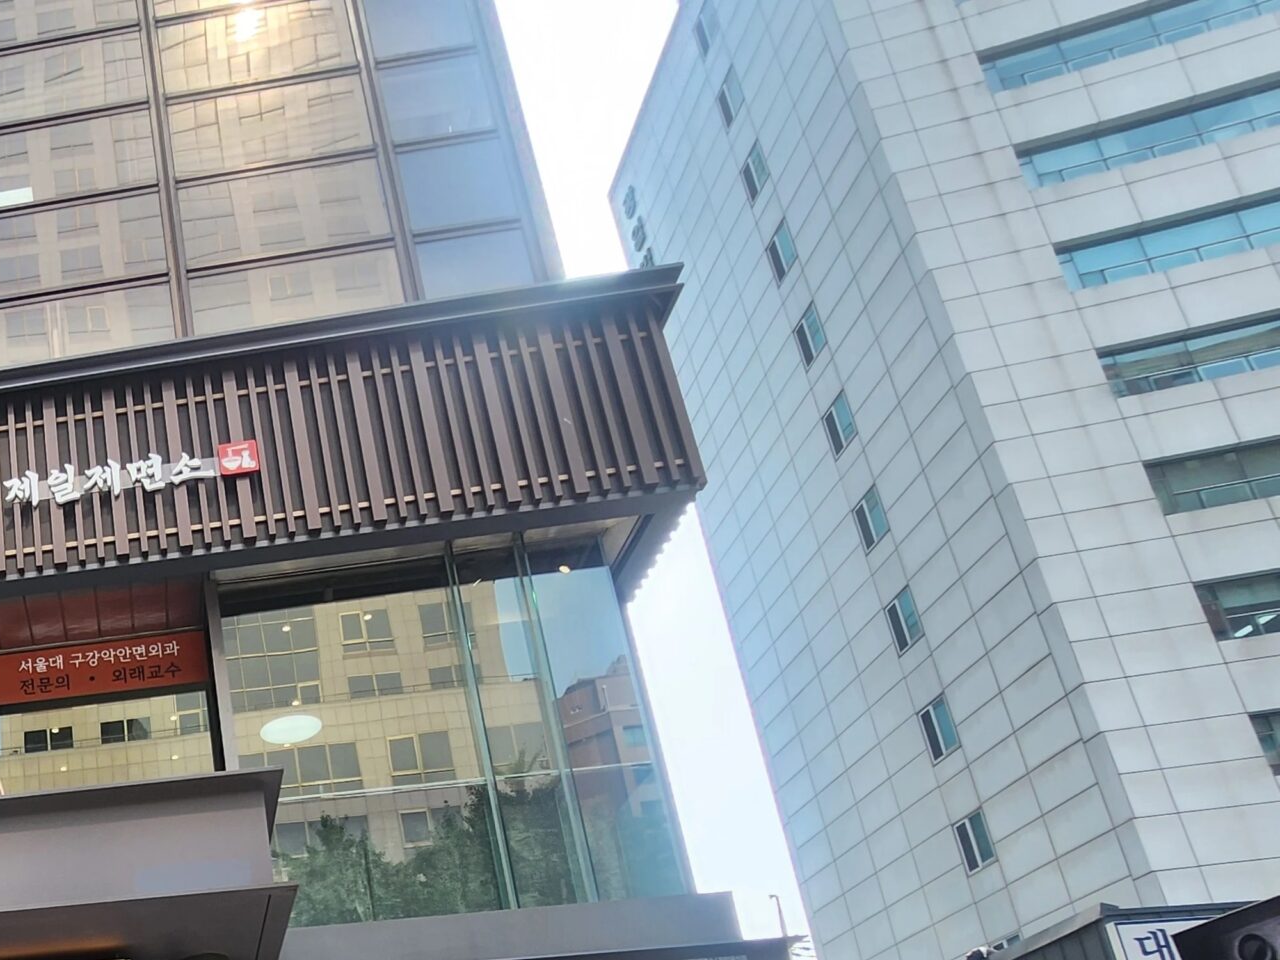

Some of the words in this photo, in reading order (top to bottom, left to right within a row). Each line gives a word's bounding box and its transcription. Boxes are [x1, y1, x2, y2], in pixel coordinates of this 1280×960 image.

[3, 450, 215, 508] 제일제면소
[19, 654, 64, 674] 서울대
[70, 641, 180, 669] 구강악안면외과
[19, 674, 71, 696] 전문의
[112, 662, 183, 684] 외래교수
